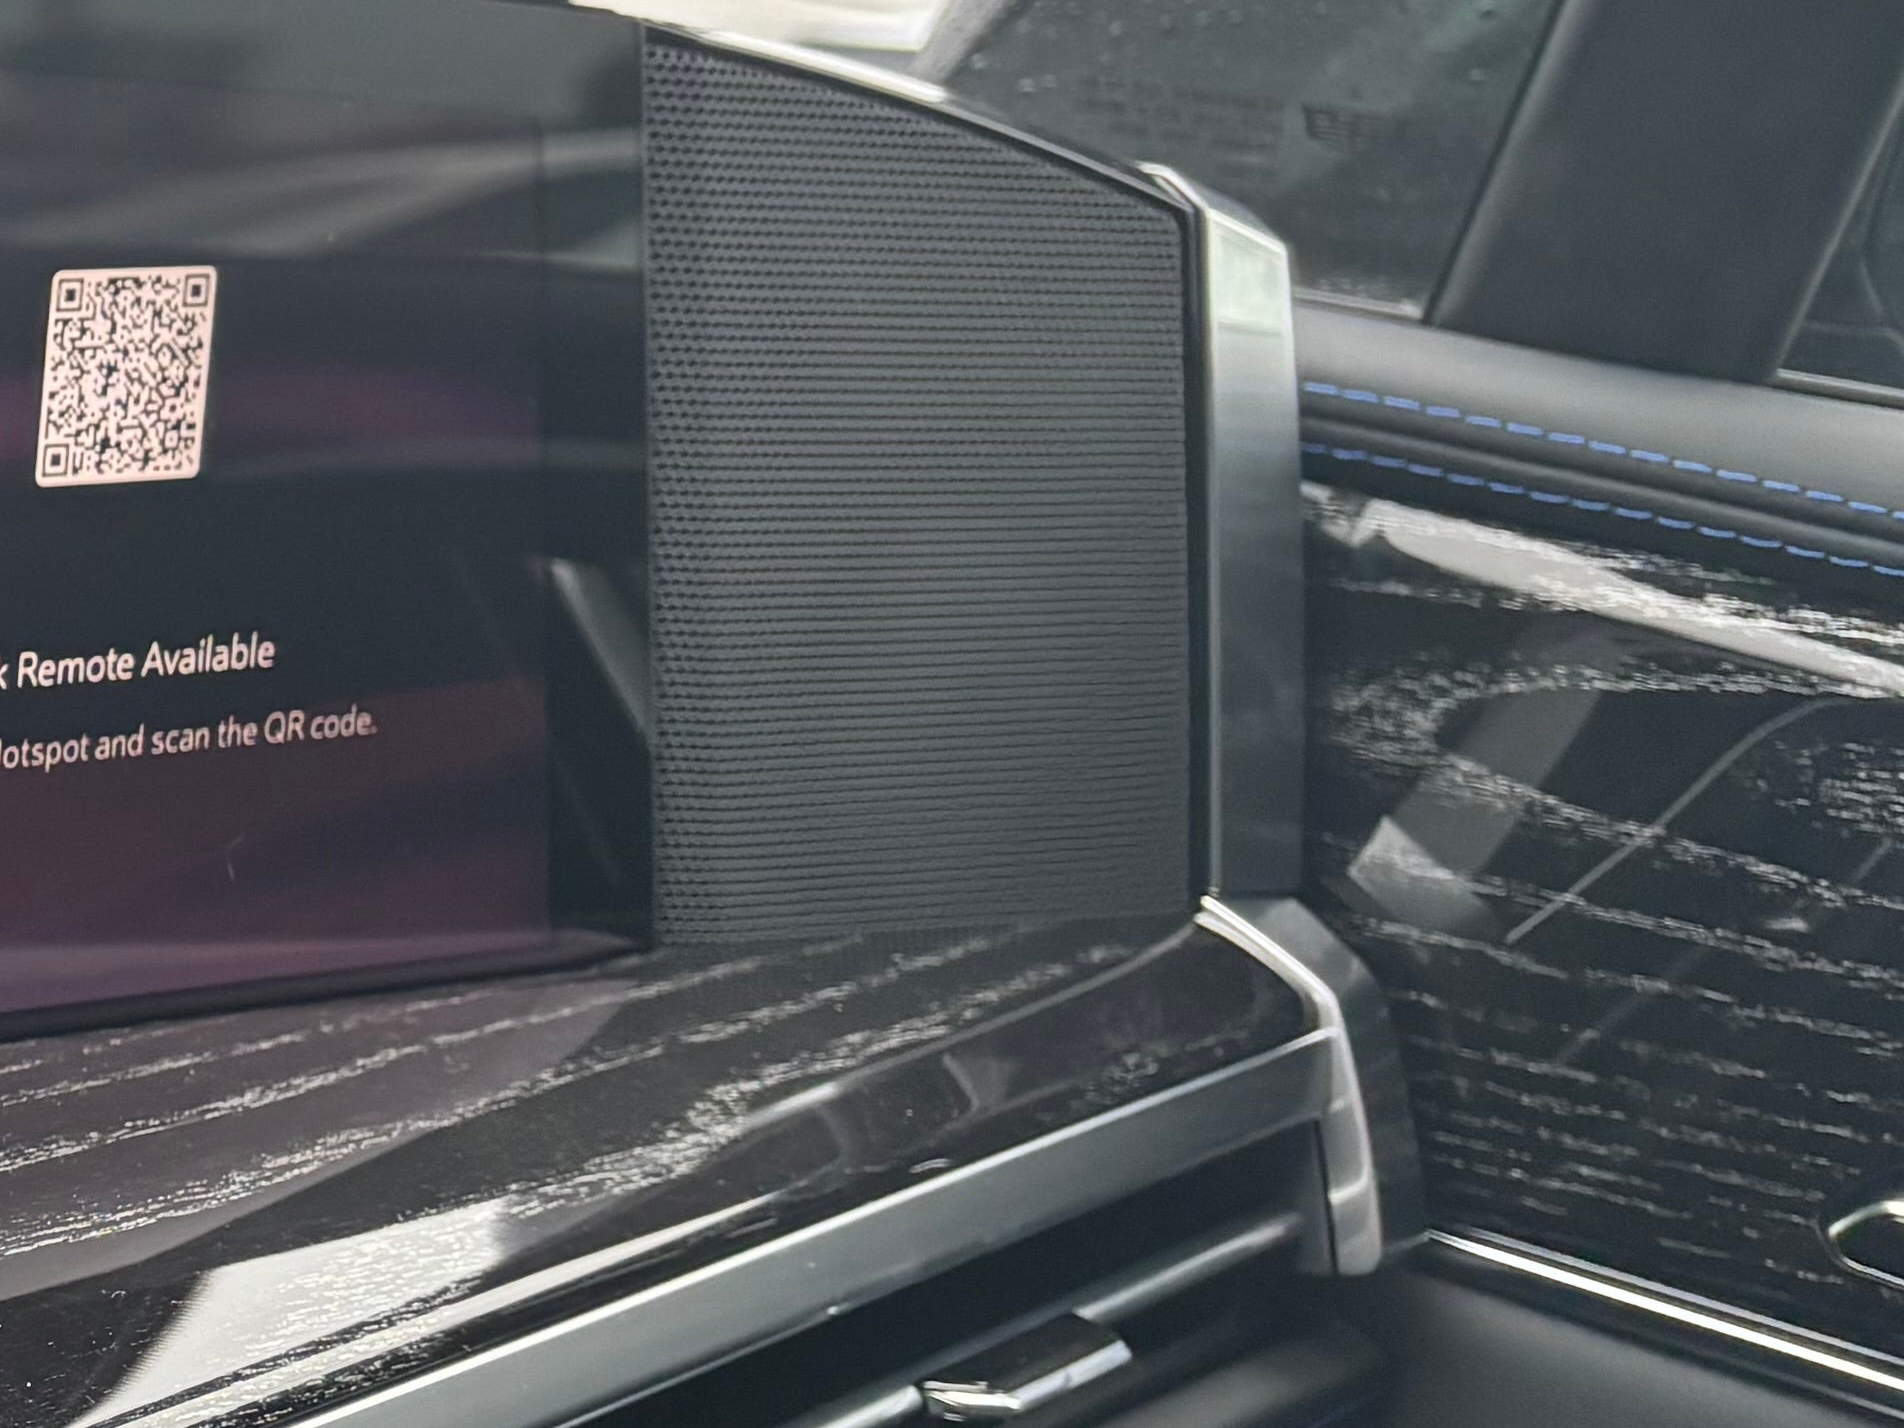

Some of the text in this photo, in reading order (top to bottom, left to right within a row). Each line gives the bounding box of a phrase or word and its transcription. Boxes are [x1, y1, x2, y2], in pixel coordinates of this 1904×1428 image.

[16, 648, 136, 688] Remote
[139, 631, 276, 677] Available
[93, 723, 146, 761] and
[150, 727, 211, 755] scan
[217, 716, 259, 748] the
[263, 709, 306, 744] QR
[309, 704, 379, 740] code.
